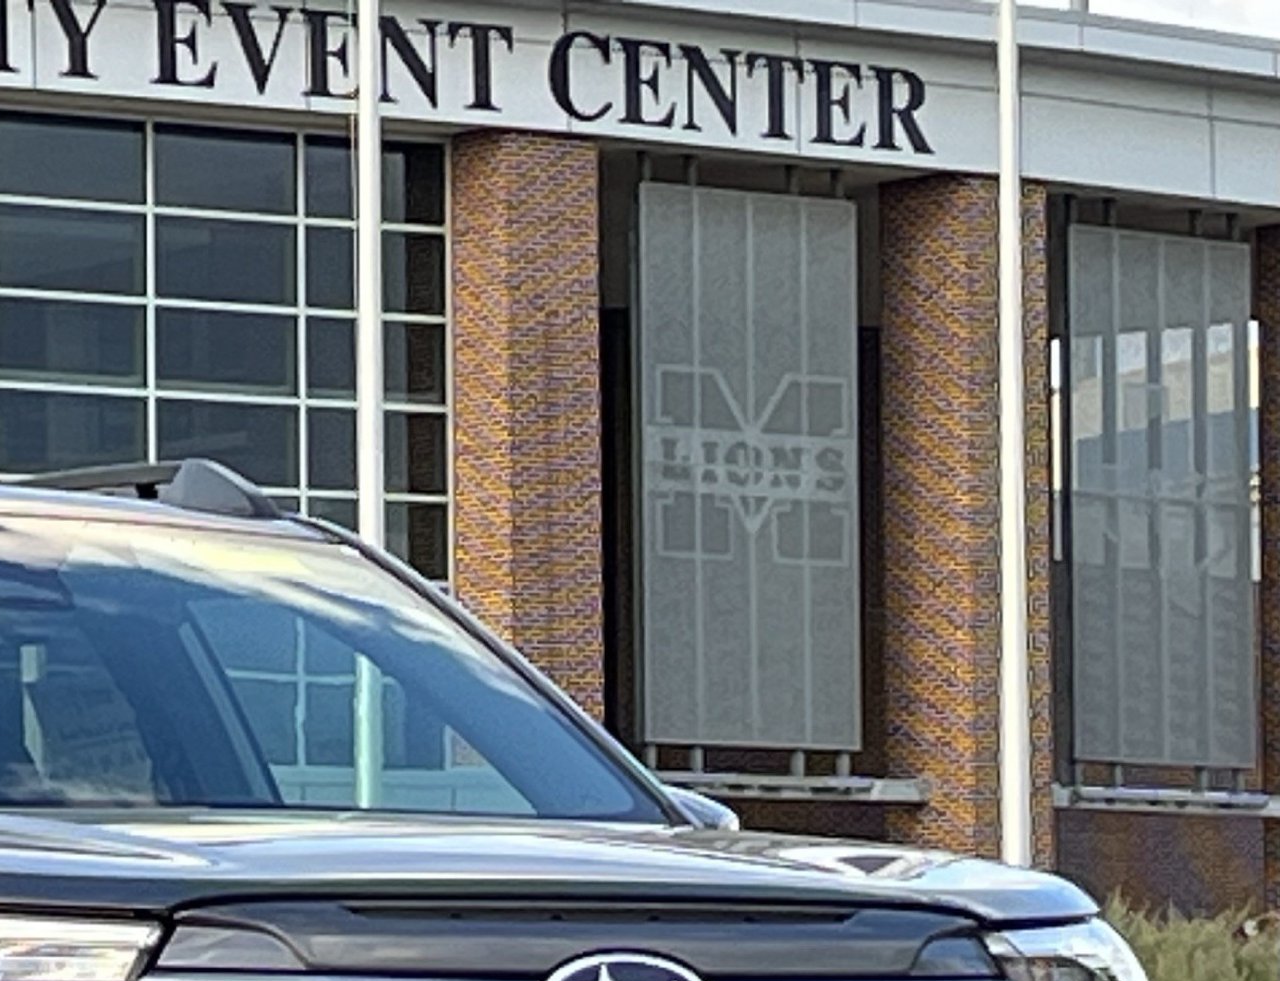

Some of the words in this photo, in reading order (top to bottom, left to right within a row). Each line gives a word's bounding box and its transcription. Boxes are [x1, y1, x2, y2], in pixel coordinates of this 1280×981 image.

[149, 0, 515, 112] EVENT
[548, 31, 936, 155] CENTER
[660, 435, 846, 493] LIONS
